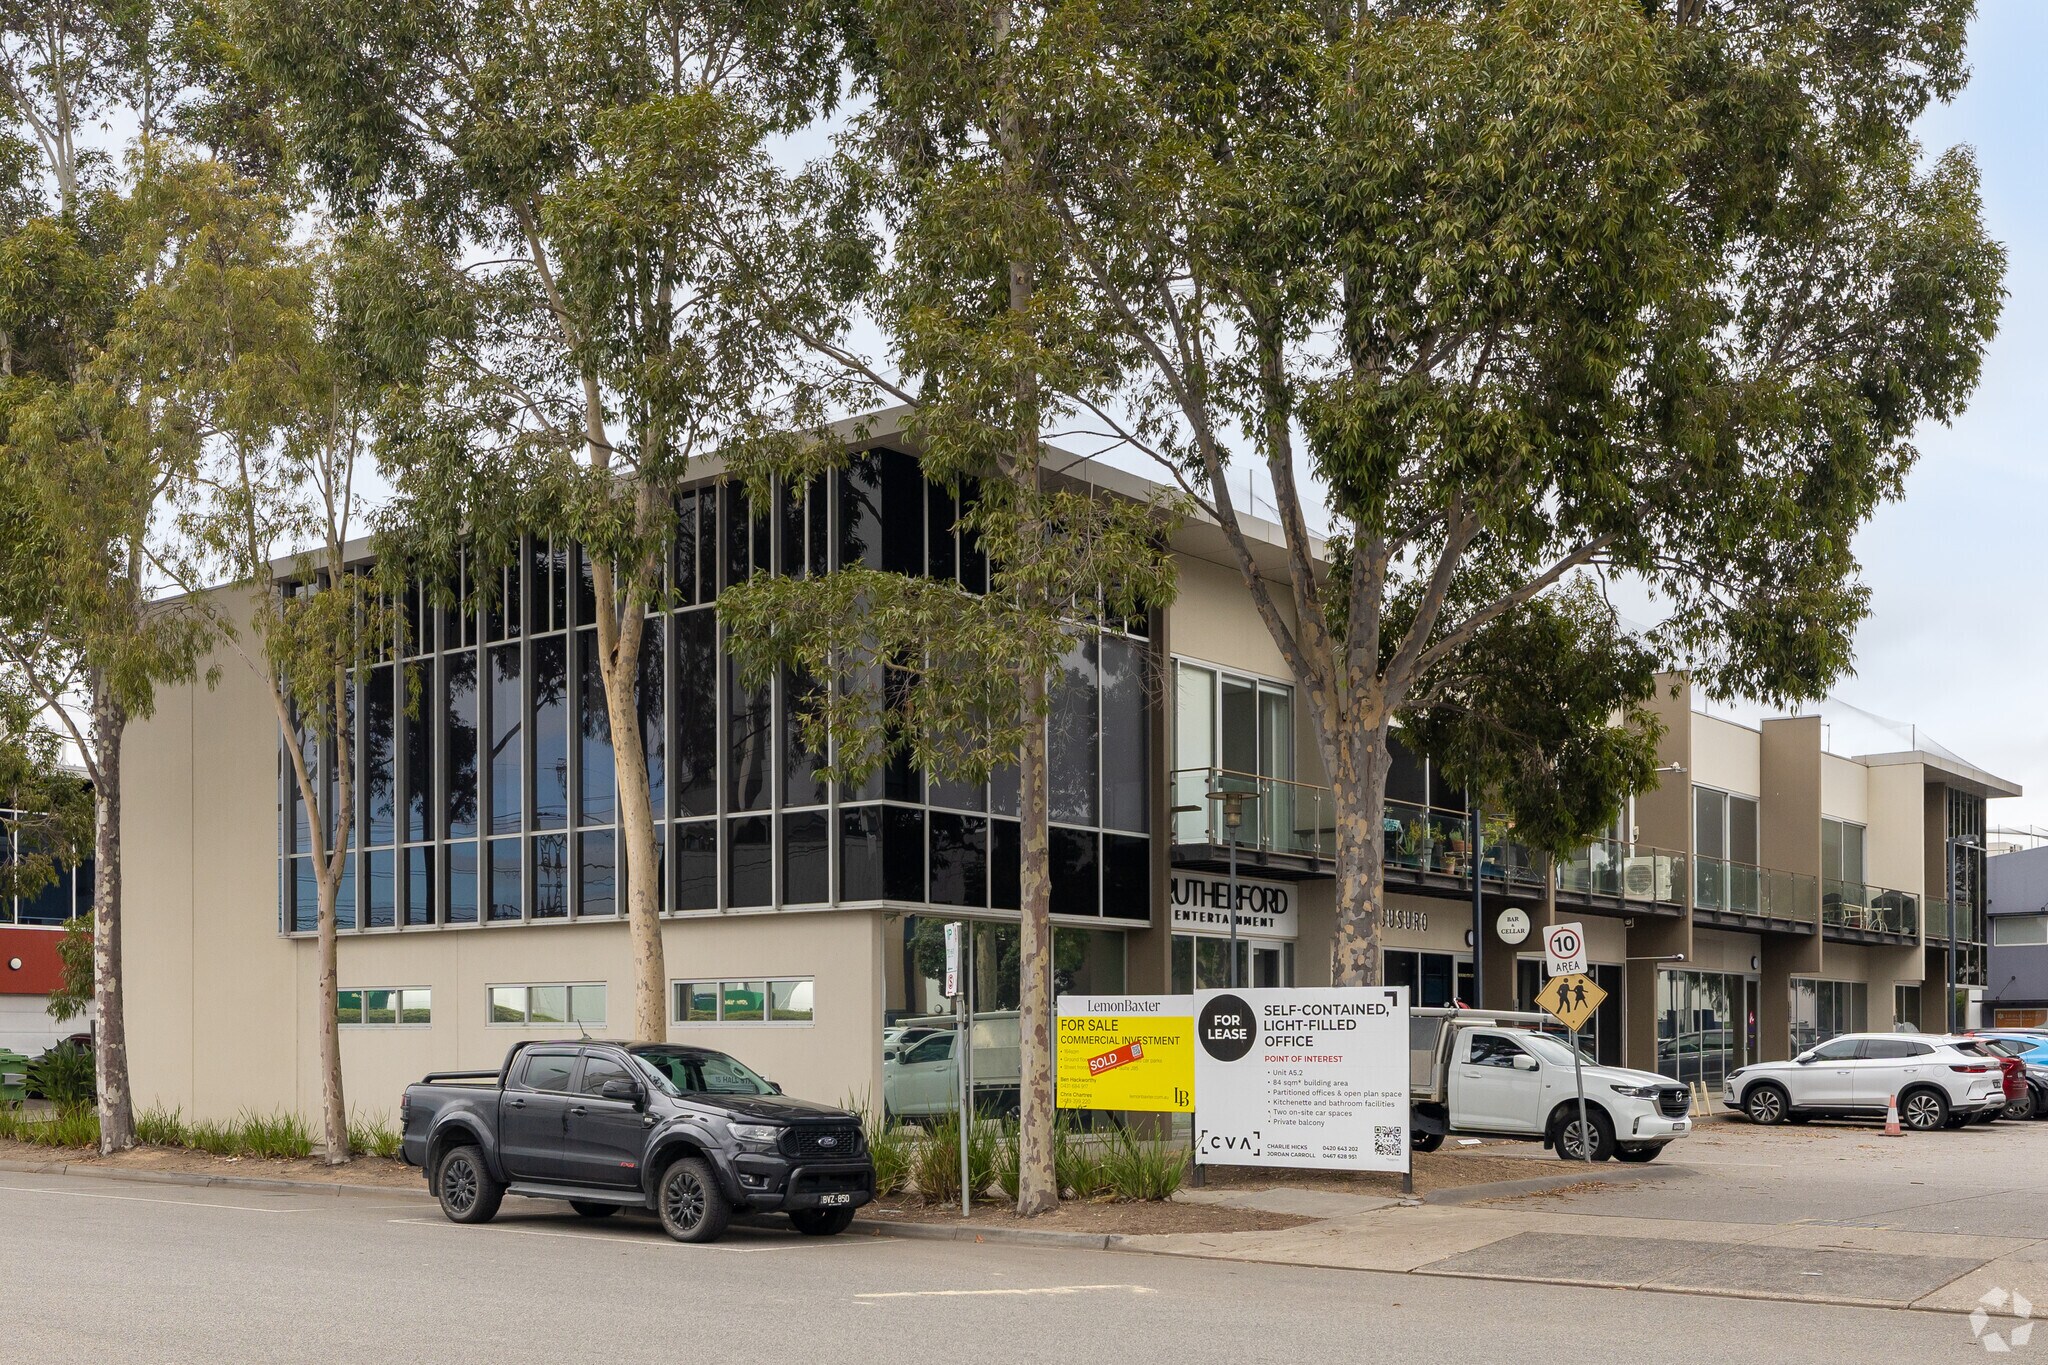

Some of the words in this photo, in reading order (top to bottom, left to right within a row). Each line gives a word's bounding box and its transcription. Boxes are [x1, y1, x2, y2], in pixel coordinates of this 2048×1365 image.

[1175, 910, 1274, 928] ENTERTANMENT
[1554, 936, 1575, 952] 10
[1556, 961, 1580, 972] AREA
[1088, 1000, 1160, 1012] LemonBaxter
[1264, 1004, 1389, 1017] SELF-CONTAINED,
[1061, 1020, 1085, 1031] FOR
[1088, 1020, 1118, 1031] SALE
[1214, 1015, 1240, 1026] FOR
[1264, 1019, 1356, 1031] LIGHT-FILLED
[1061, 1036, 1120, 1045] COMMERCIAL
[1122, 1036, 1180, 1045] INVESTMENT
[1208, 1029, 1247, 1040] LEASE
[1265, 1036, 1313, 1047] OFFICE
[1090, 1053, 1118, 1071] SOLD
[1211, 1137, 1251, 1150] CVA
